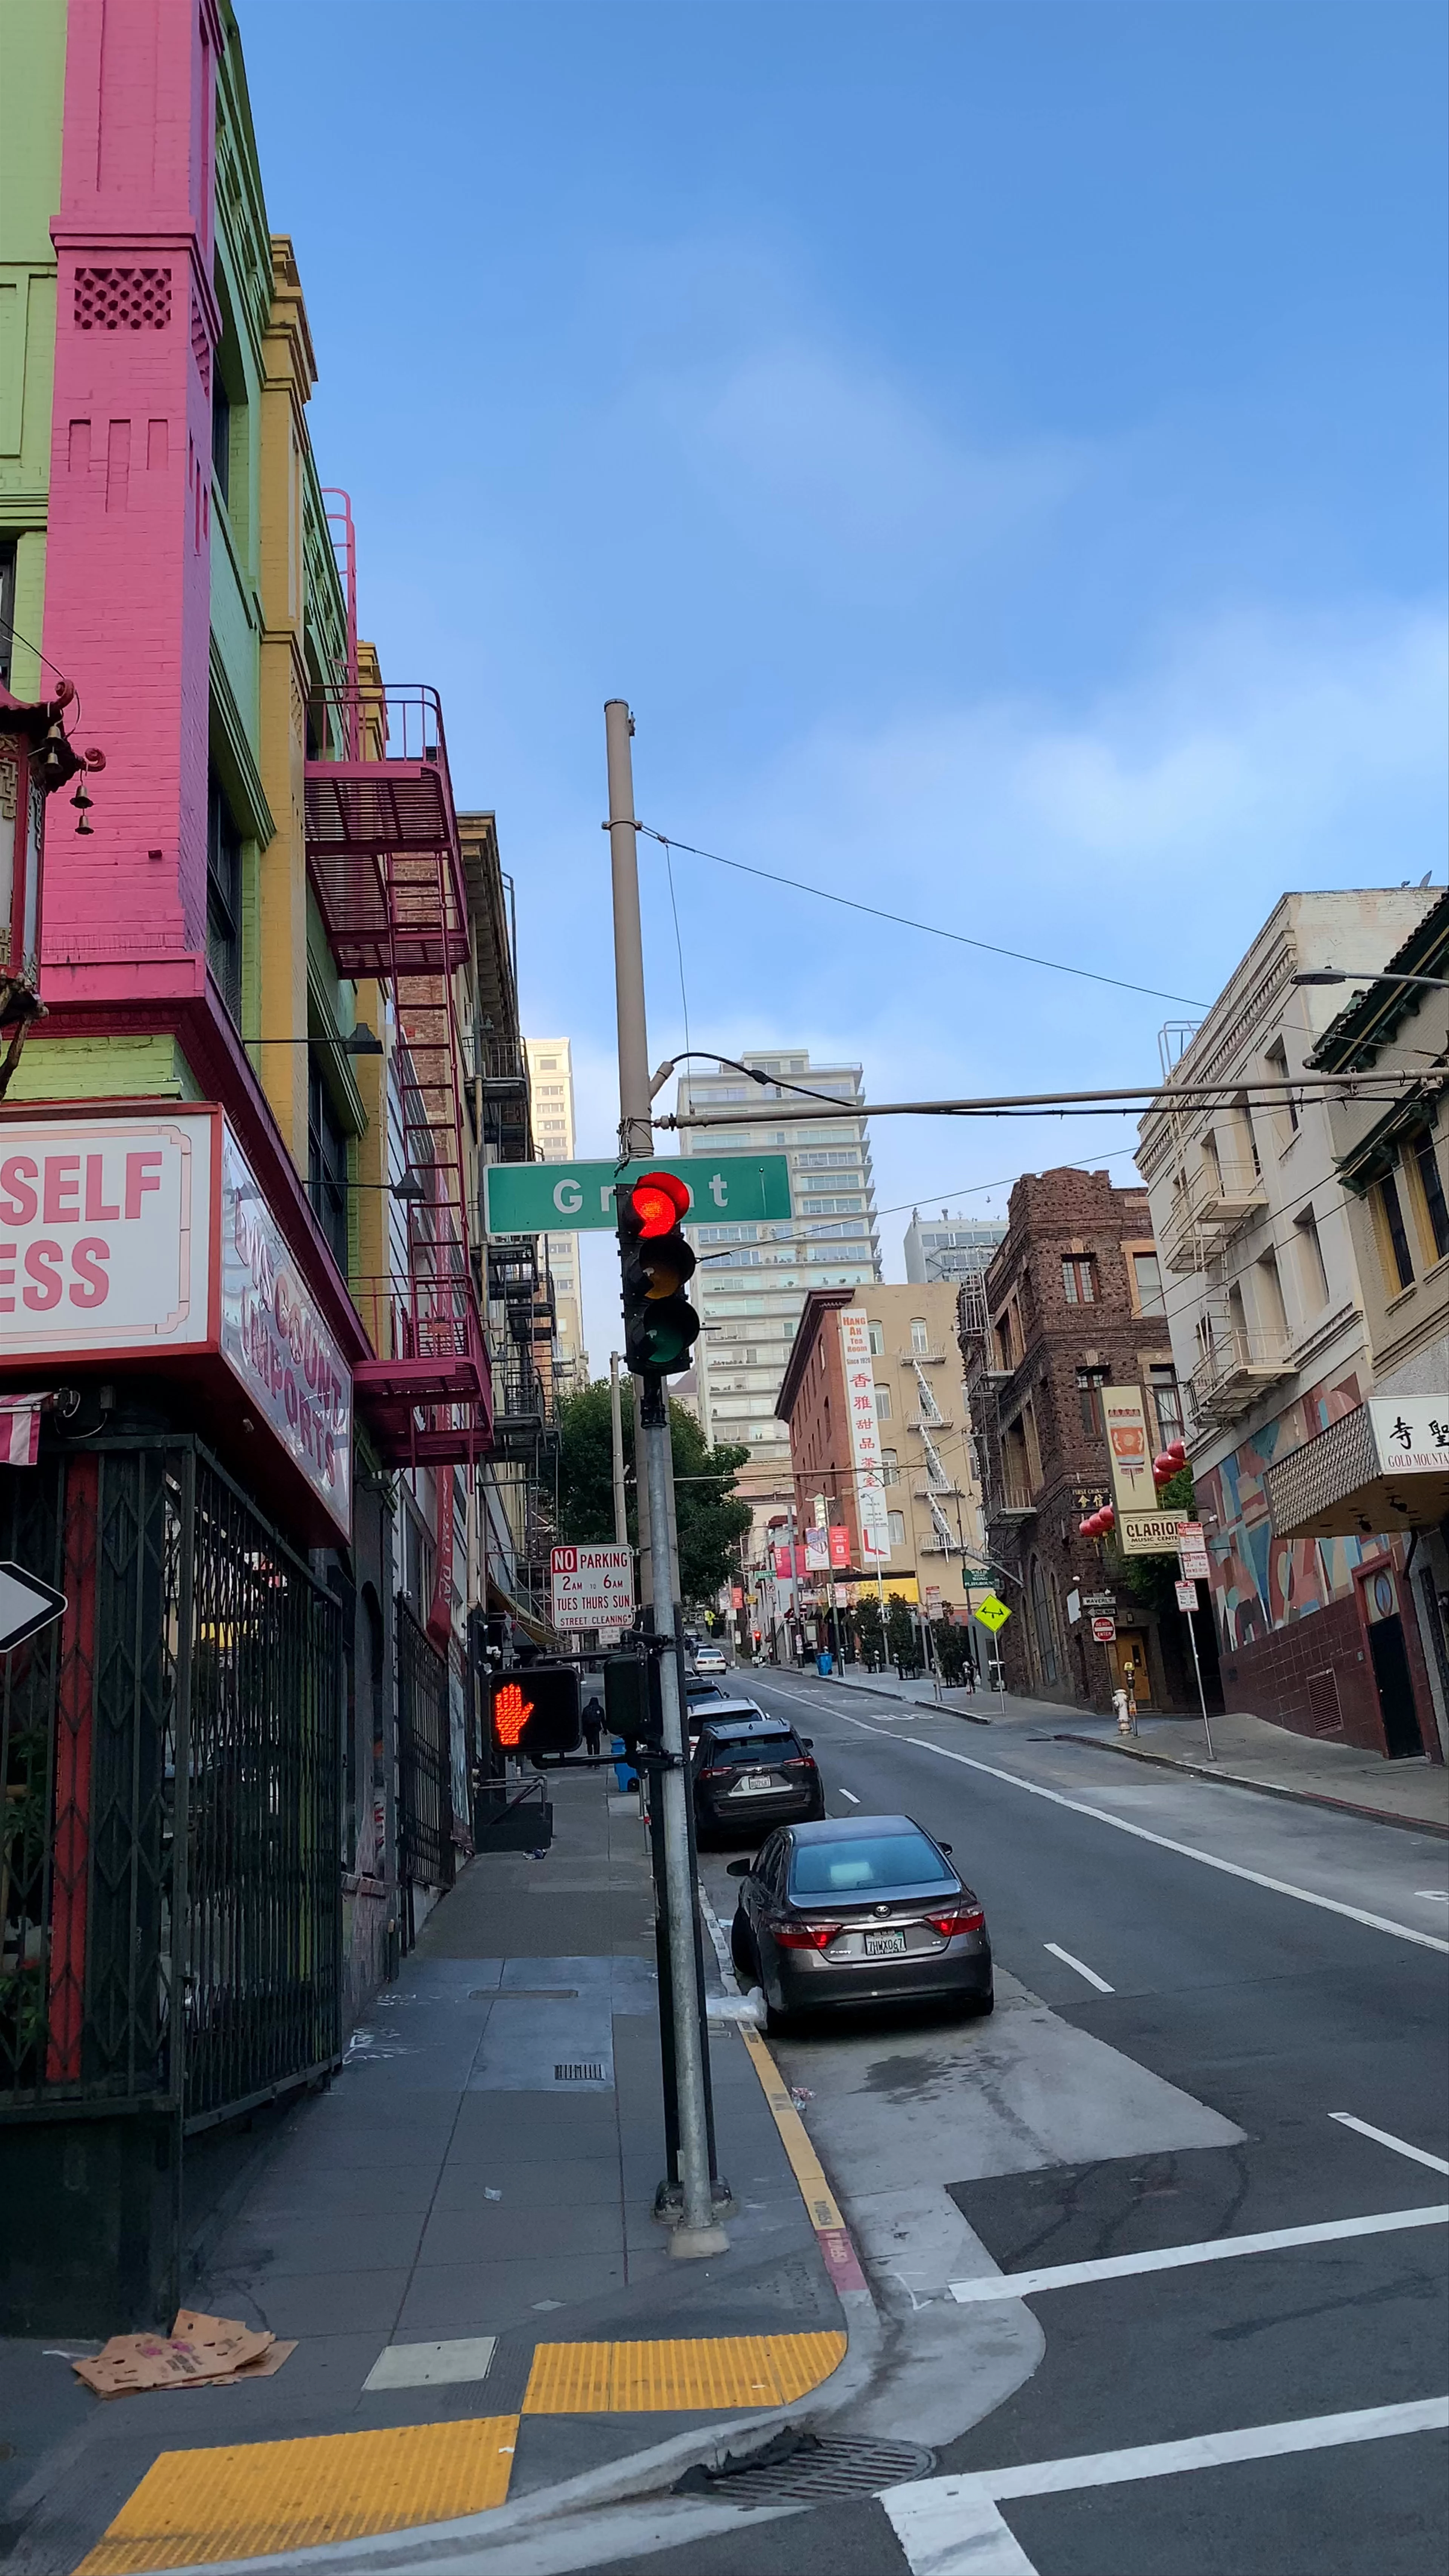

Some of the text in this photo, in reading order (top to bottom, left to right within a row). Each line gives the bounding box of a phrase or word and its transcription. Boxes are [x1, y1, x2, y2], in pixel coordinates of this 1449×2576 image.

[0, 1152, 162, 1226] SELF
[553, 1173, 728, 1214] Grt
[843, 1317, 866, 1326] HANG
[850, 1327, 861, 1335] AH
[241, 1284, 335, 1487] IMPORTS
[1388, 1454, 1412, 1467] GOLD
[555, 1550, 628, 1570] NO PARKING
[563, 1576, 582, 1591] 2AM
[604, 1574, 623, 1589] 6AM
[557, 1595, 629, 1611] TUES THURS SUN
[560, 1614, 628, 1626] STREET CLEANING
[868, 1938, 903, 1952] 7HWX067
